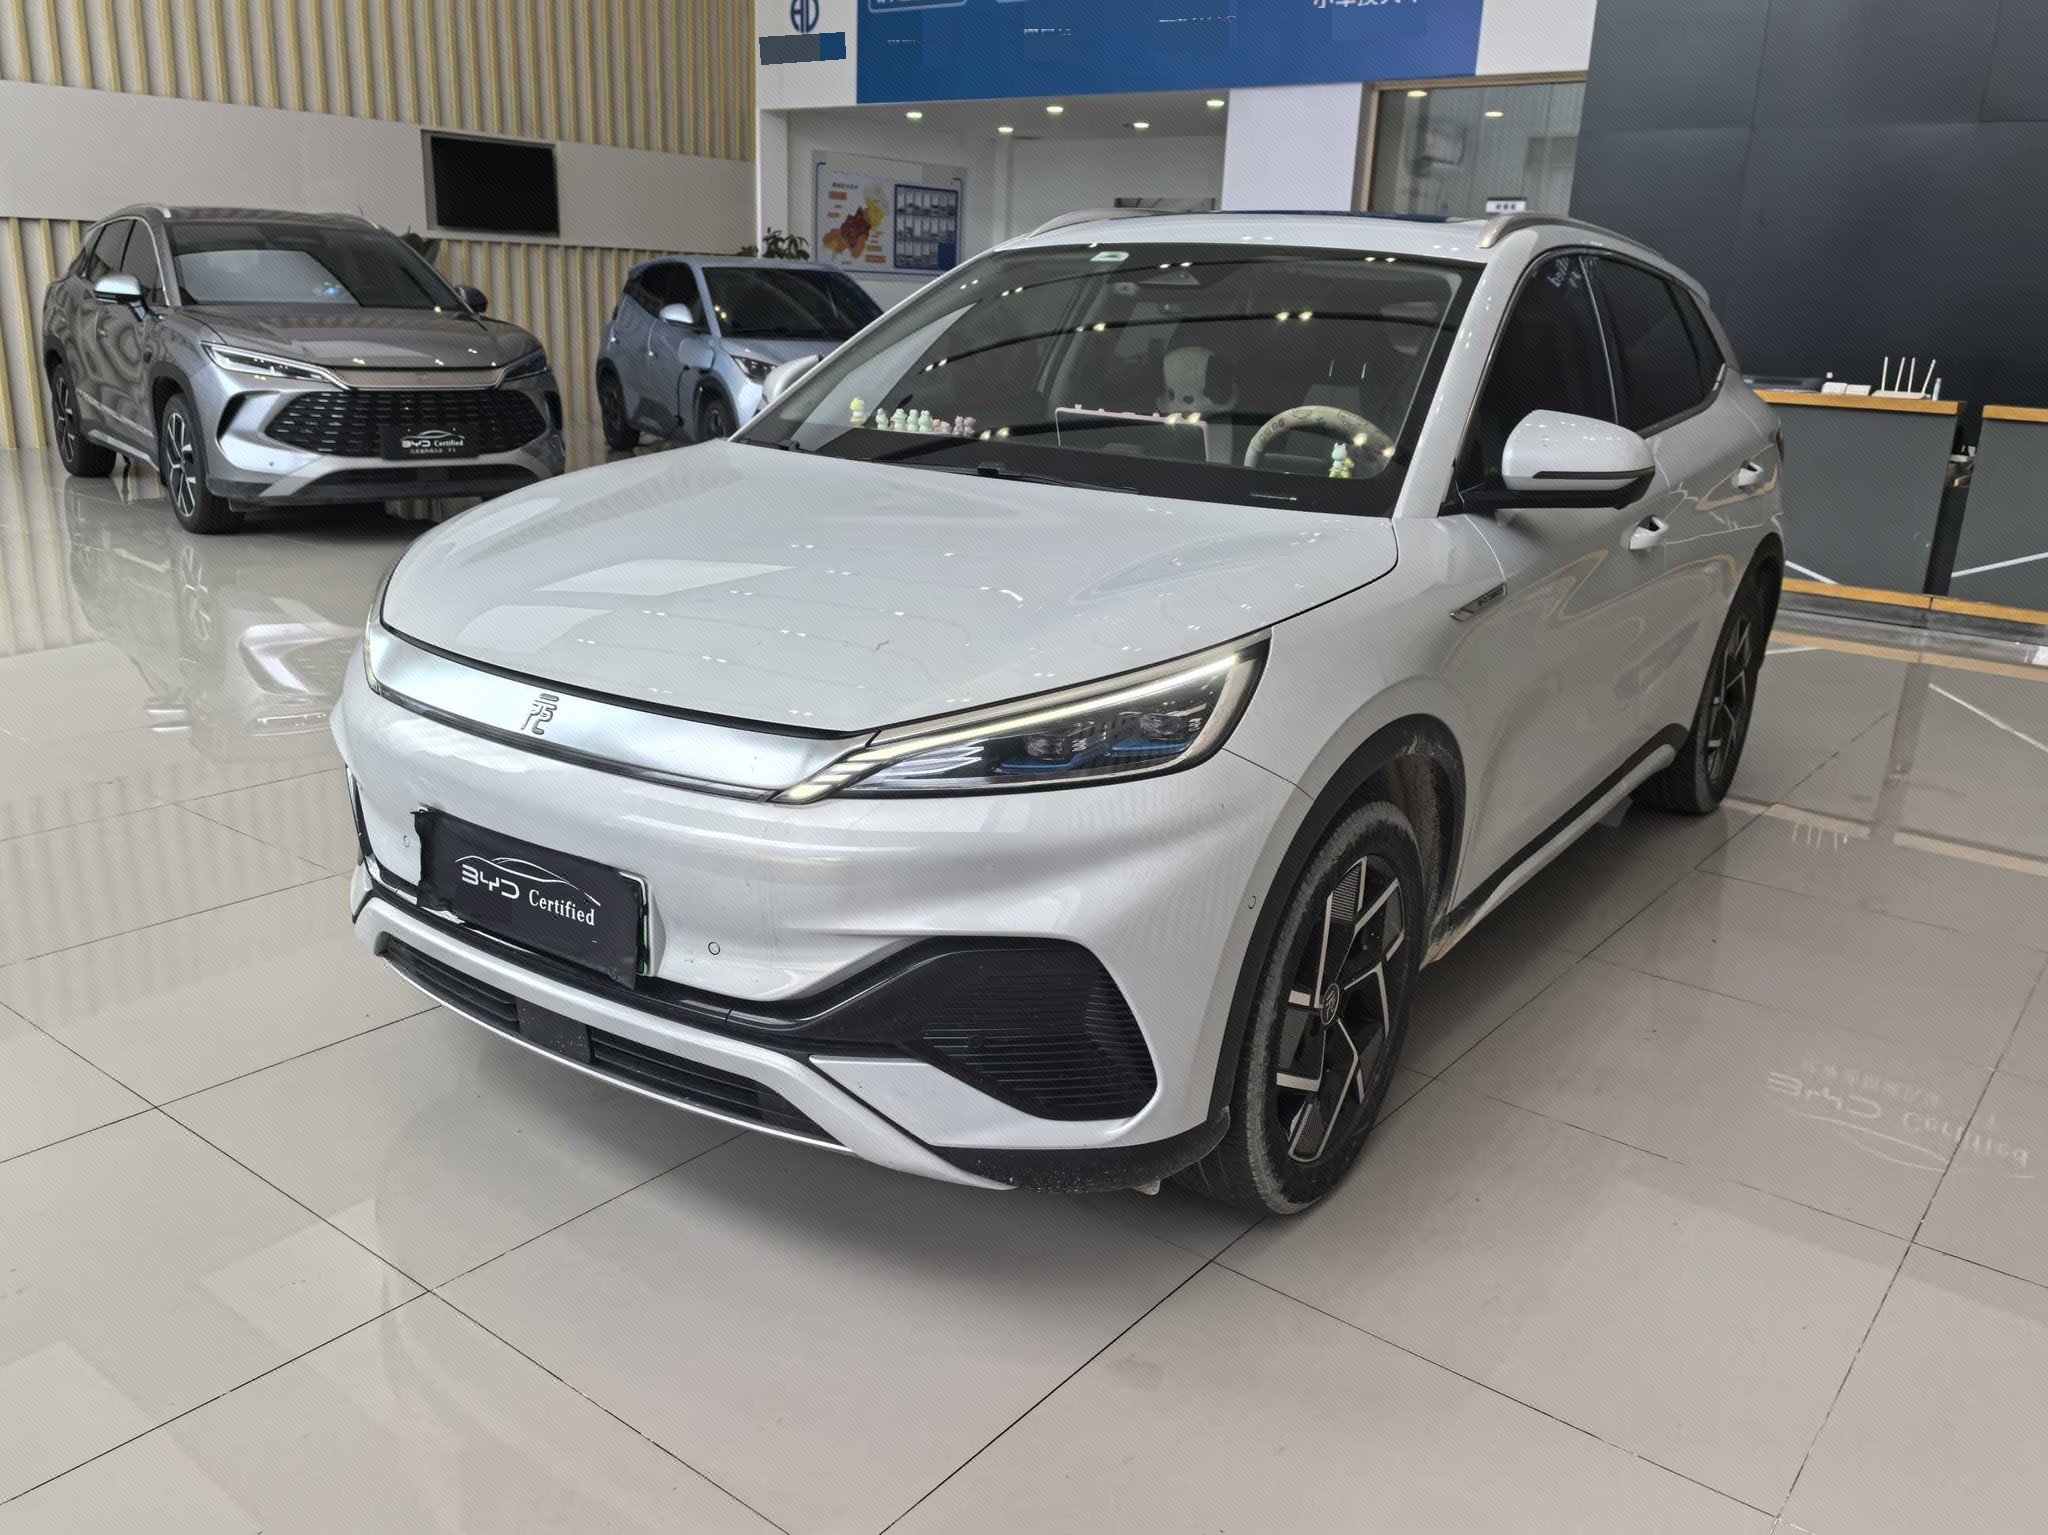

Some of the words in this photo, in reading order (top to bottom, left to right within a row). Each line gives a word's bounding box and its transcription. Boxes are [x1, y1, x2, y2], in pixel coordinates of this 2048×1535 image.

[401, 440, 431, 448] BYD
[434, 439, 464, 447] Certified
[461, 863, 520, 899] BYD
[528, 888, 596, 926] Certified
